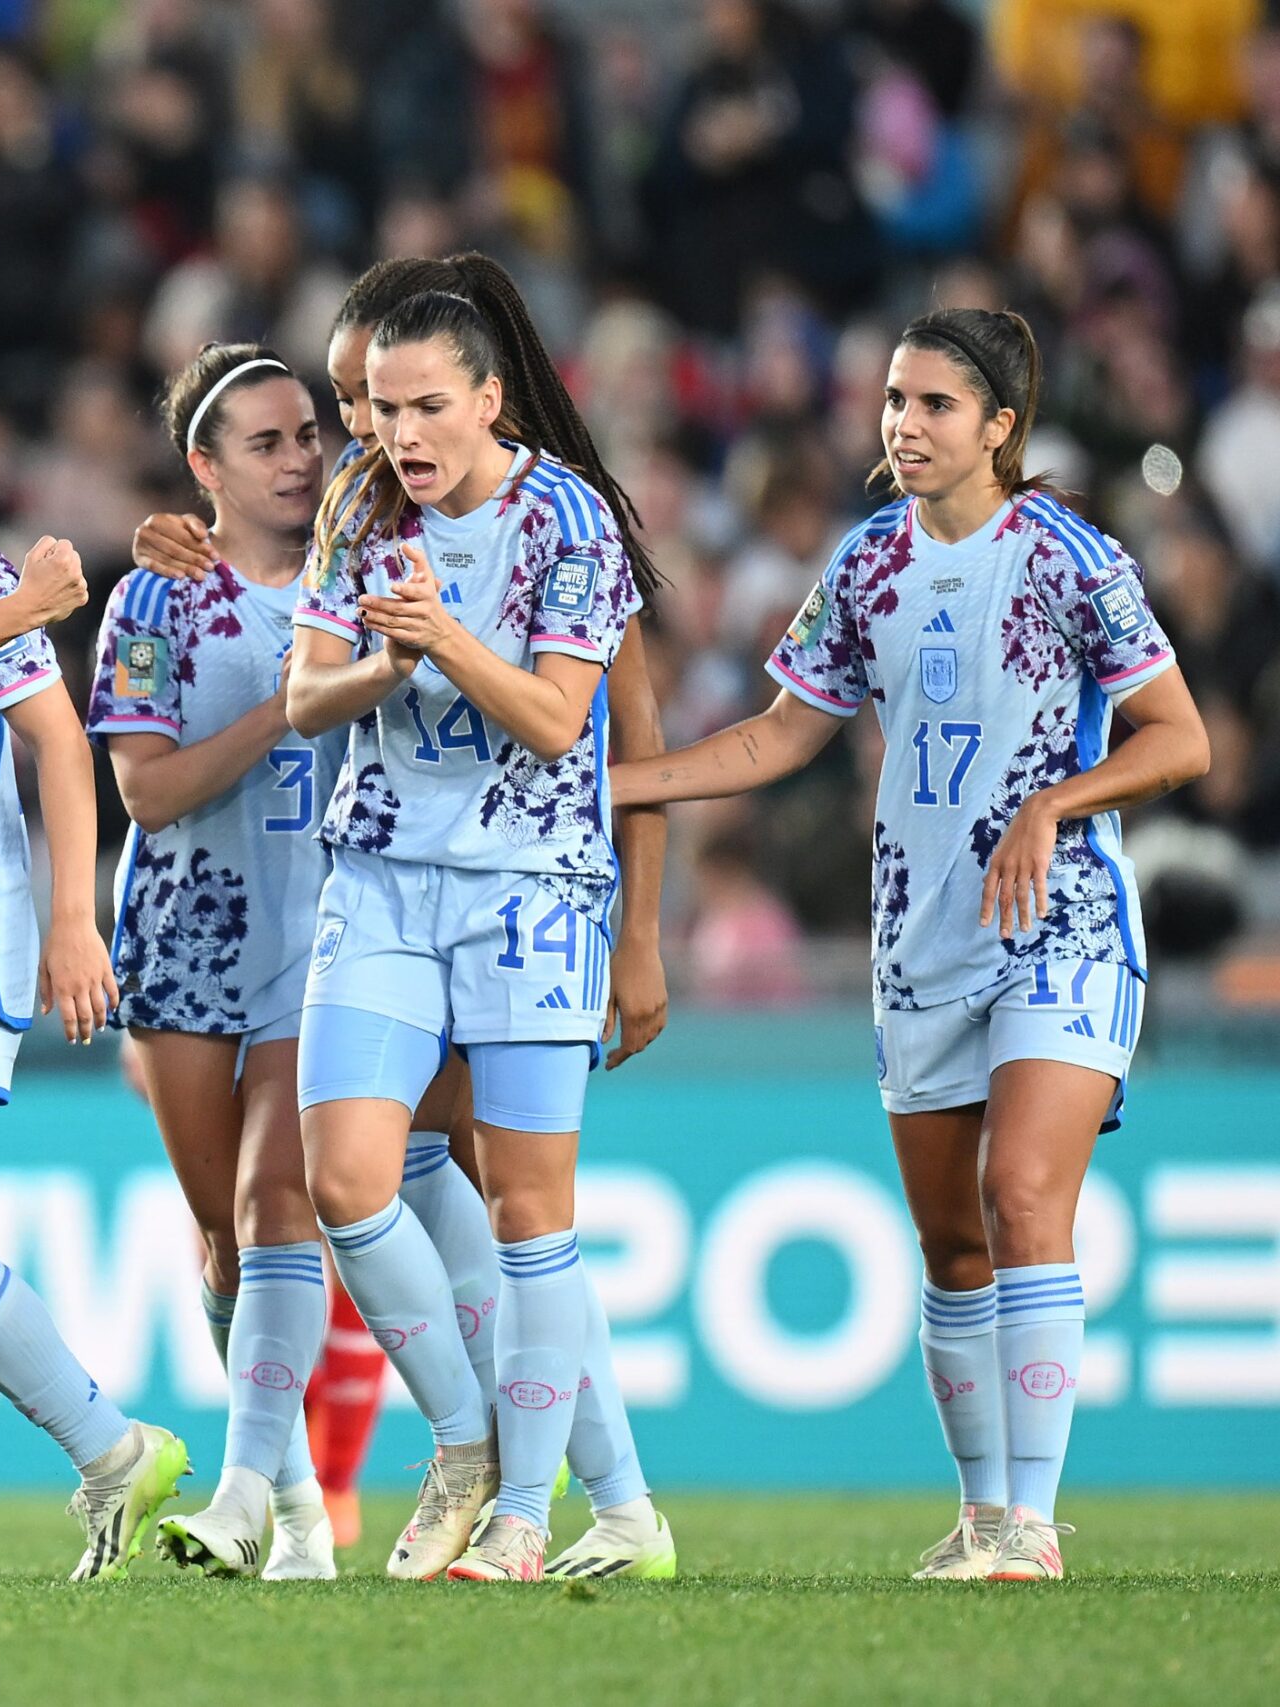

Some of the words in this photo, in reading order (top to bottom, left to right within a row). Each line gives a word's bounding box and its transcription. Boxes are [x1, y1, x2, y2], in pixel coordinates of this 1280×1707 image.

[556, 571, 588, 586] UNITES
[558, 562, 589, 574] FOOTBALL
[403, 686, 492, 764] 14
[912, 720, 983, 807] 17
[264, 748, 314, 832] 3
[495, 894, 579, 972] 14
[1031, 1380, 1056, 1389] EF
[1032, 1371, 1057, 1380] RF
